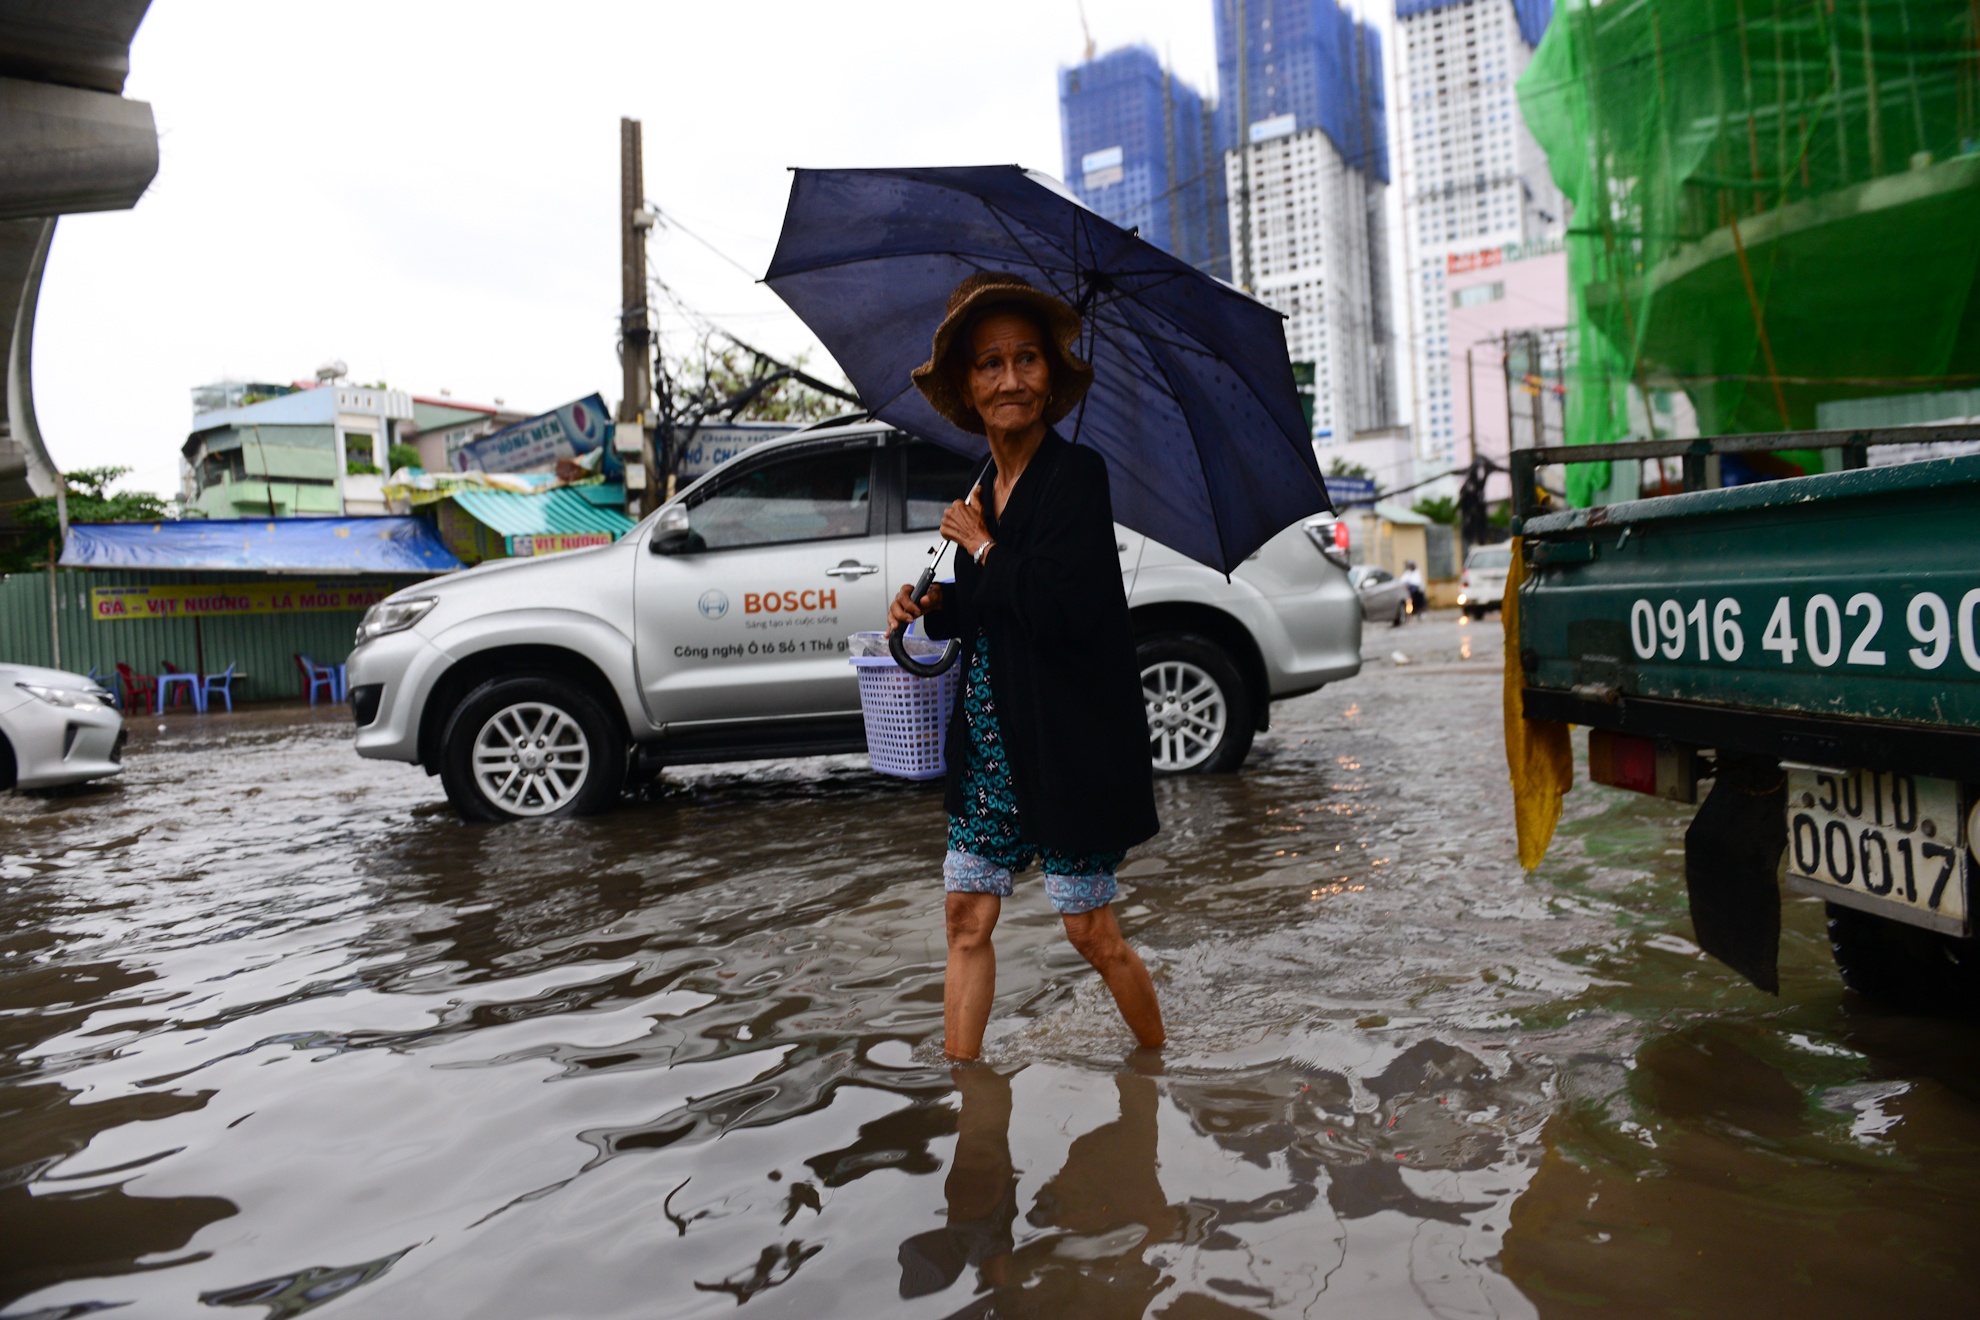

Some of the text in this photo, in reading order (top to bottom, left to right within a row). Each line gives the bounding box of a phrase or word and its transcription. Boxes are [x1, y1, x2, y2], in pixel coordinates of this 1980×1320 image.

[744, 588, 837, 615] BOSCH
[674, 645, 708, 660] Công
[712, 643, 744, 659] nghệ
[762, 641, 775, 654] tô
[778, 639, 796, 654] Số
[799, 641, 806, 652] 1
[809, 636, 834, 652] Thế
[1630, 597, 1745, 662] 0916
[1762, 592, 1887, 667] 402
[1792, 812, 1957, 910] 000.17
